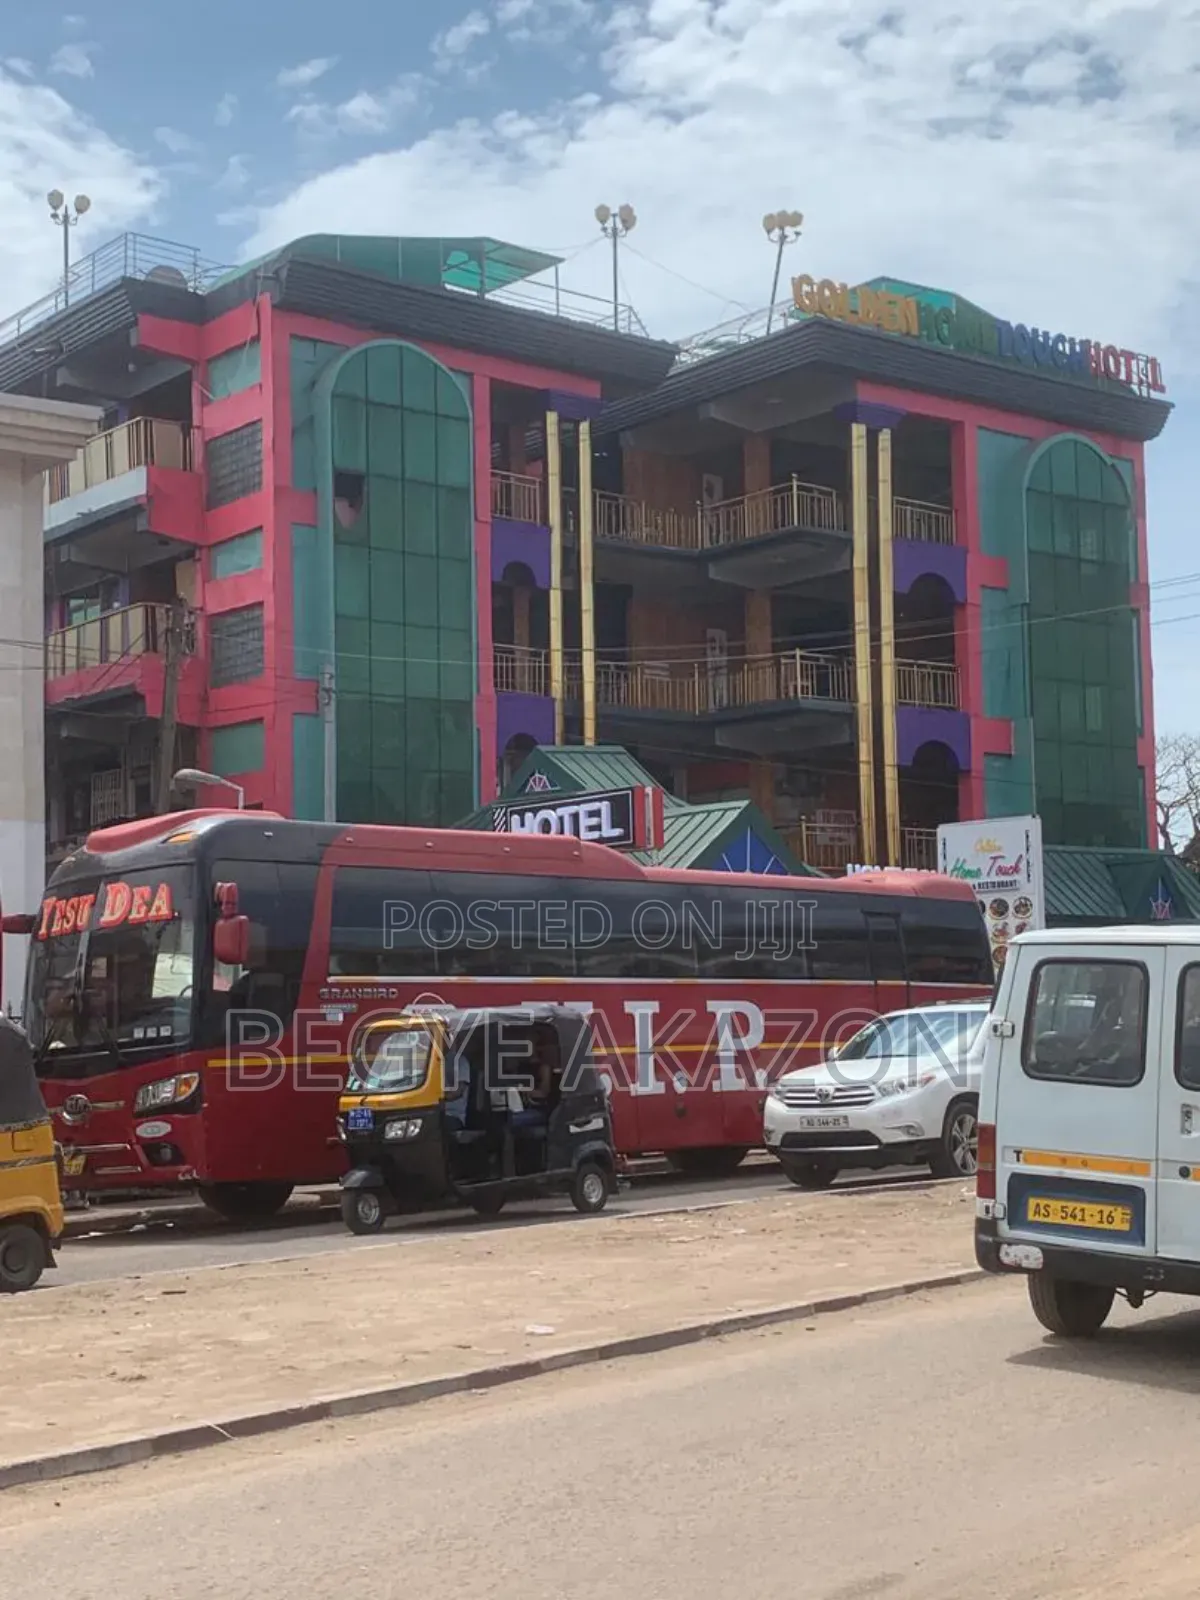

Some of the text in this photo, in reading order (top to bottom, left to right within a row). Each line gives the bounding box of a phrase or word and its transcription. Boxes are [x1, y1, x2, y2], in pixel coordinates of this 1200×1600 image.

[791, 273, 919, 337] GOLDEN
[1085, 339, 1167, 393] HOTEL
[511, 801, 624, 841] HOTEL
[985, 854, 1023, 878] Touch
[37, 881, 173, 941] YESU DEA
[319, 987, 399, 1000] GRANBIRD
[521, 1000, 768, 1097] .I.P.
[1033, 1202, 1051, 1218] AS
